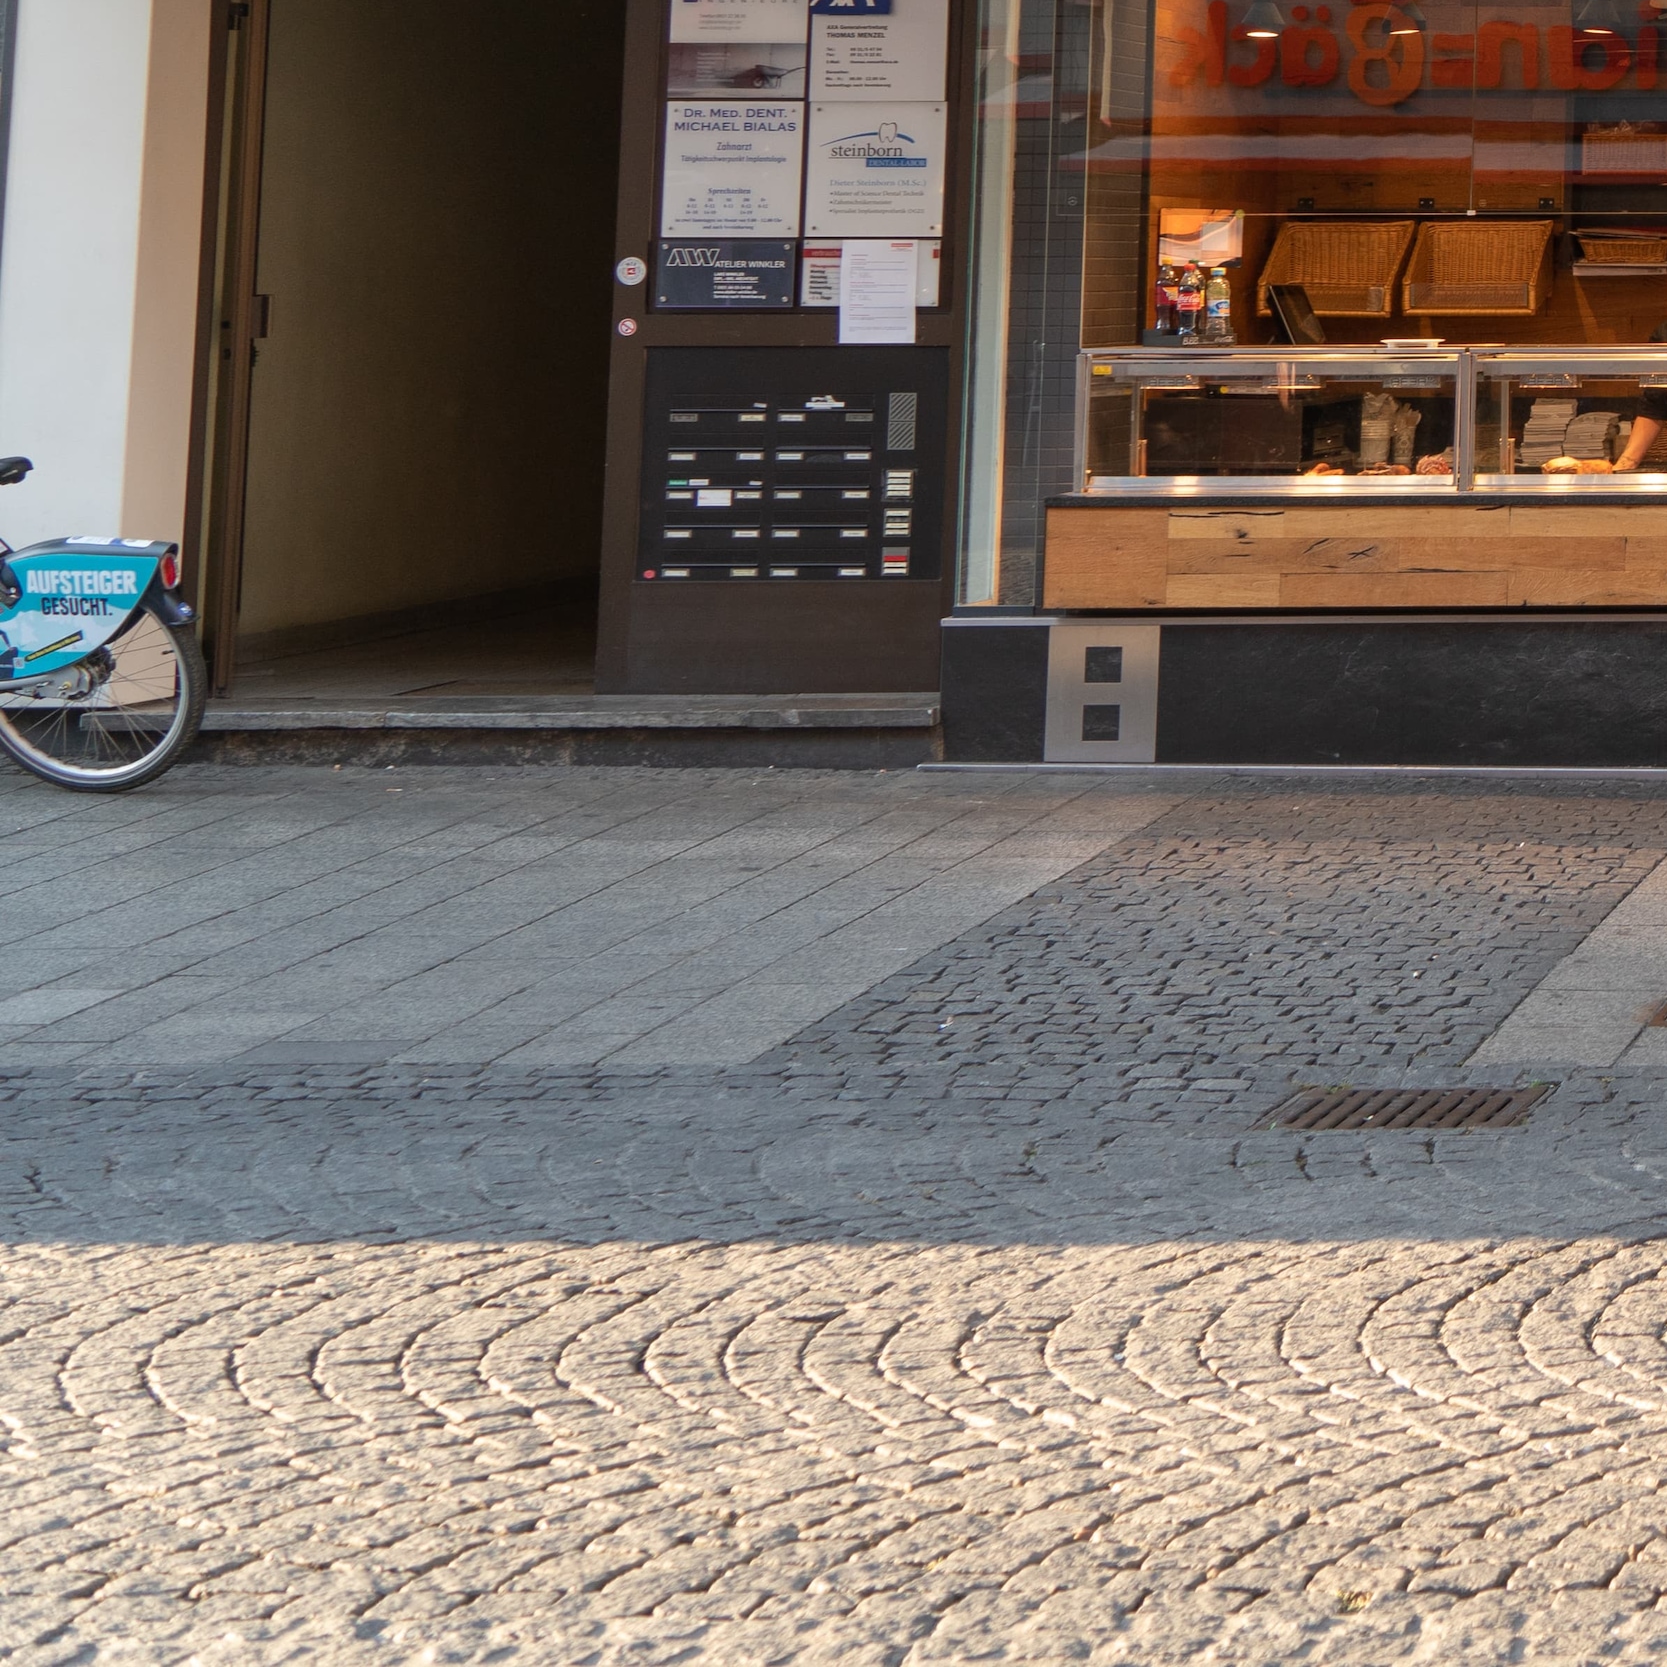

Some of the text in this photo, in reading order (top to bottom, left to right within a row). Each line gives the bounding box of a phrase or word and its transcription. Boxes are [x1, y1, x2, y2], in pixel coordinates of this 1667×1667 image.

[746, 109, 787, 118] DENT.
[674, 122, 796, 132] MICHAEL BIALAS
[716, 142, 752, 151] Zahnarzt
[831, 143, 903, 157] steinborn
[830, 179, 855, 187] Dieter
[857, 179, 895, 187] Steinborn
[714, 260, 786, 268] ATELIER WINKLER
[26, 570, 138, 595] AUFSTEIGER
[41, 597, 113, 616] GESUCHT.
